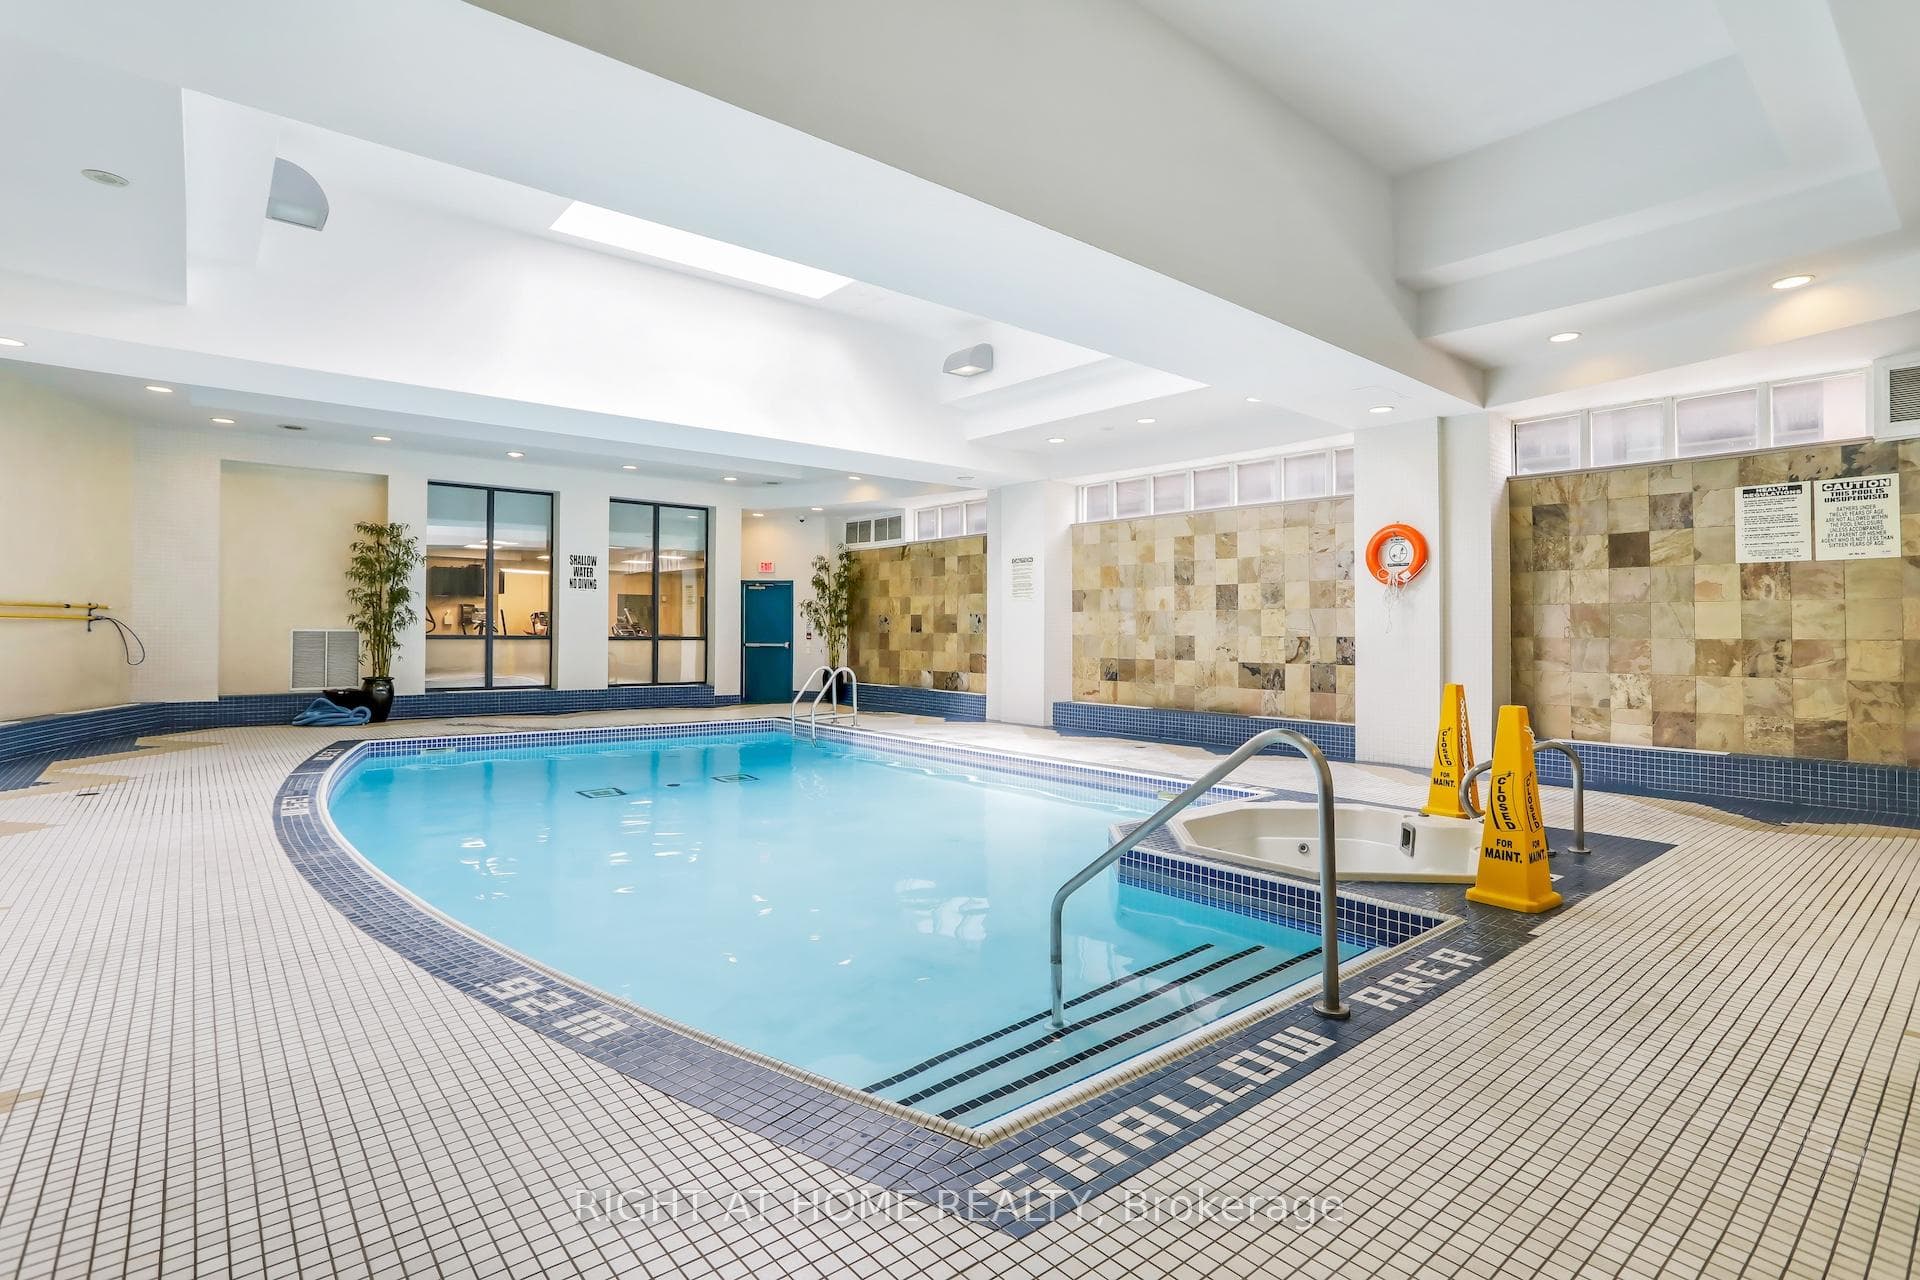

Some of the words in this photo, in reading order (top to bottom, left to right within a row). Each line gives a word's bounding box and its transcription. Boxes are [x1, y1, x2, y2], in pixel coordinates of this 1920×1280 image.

[1823, 479, 1890, 491] CAUTION
[1744, 489, 1802, 499] REGULATIONS
[1824, 493, 1889, 503] UNSUPERVISED
[569, 554, 597, 566] SHALLOW
[573, 566, 594, 578] WATER
[760, 562, 772, 571] EXIT
[569, 578, 577, 589] NO
[578, 578, 597, 590] DIVING
[1440, 729, 1453, 767] CLOSED
[1440, 771, 1451, 779] FOR
[1433, 778, 1456, 788] MAINT.
[1496, 776, 1517, 831] CLOSED
[1524, 777, 1540, 829] CLOSED
[1496, 838, 1513, 849] FOR
[1531, 839, 1540, 849] FOR
[1484, 847, 1523, 864] MAINT.
[1528, 848, 1547, 865] MAINT.
[974, 1025, 1337, 1206] SHALLOW
[1348, 946, 1484, 1011] AREA
